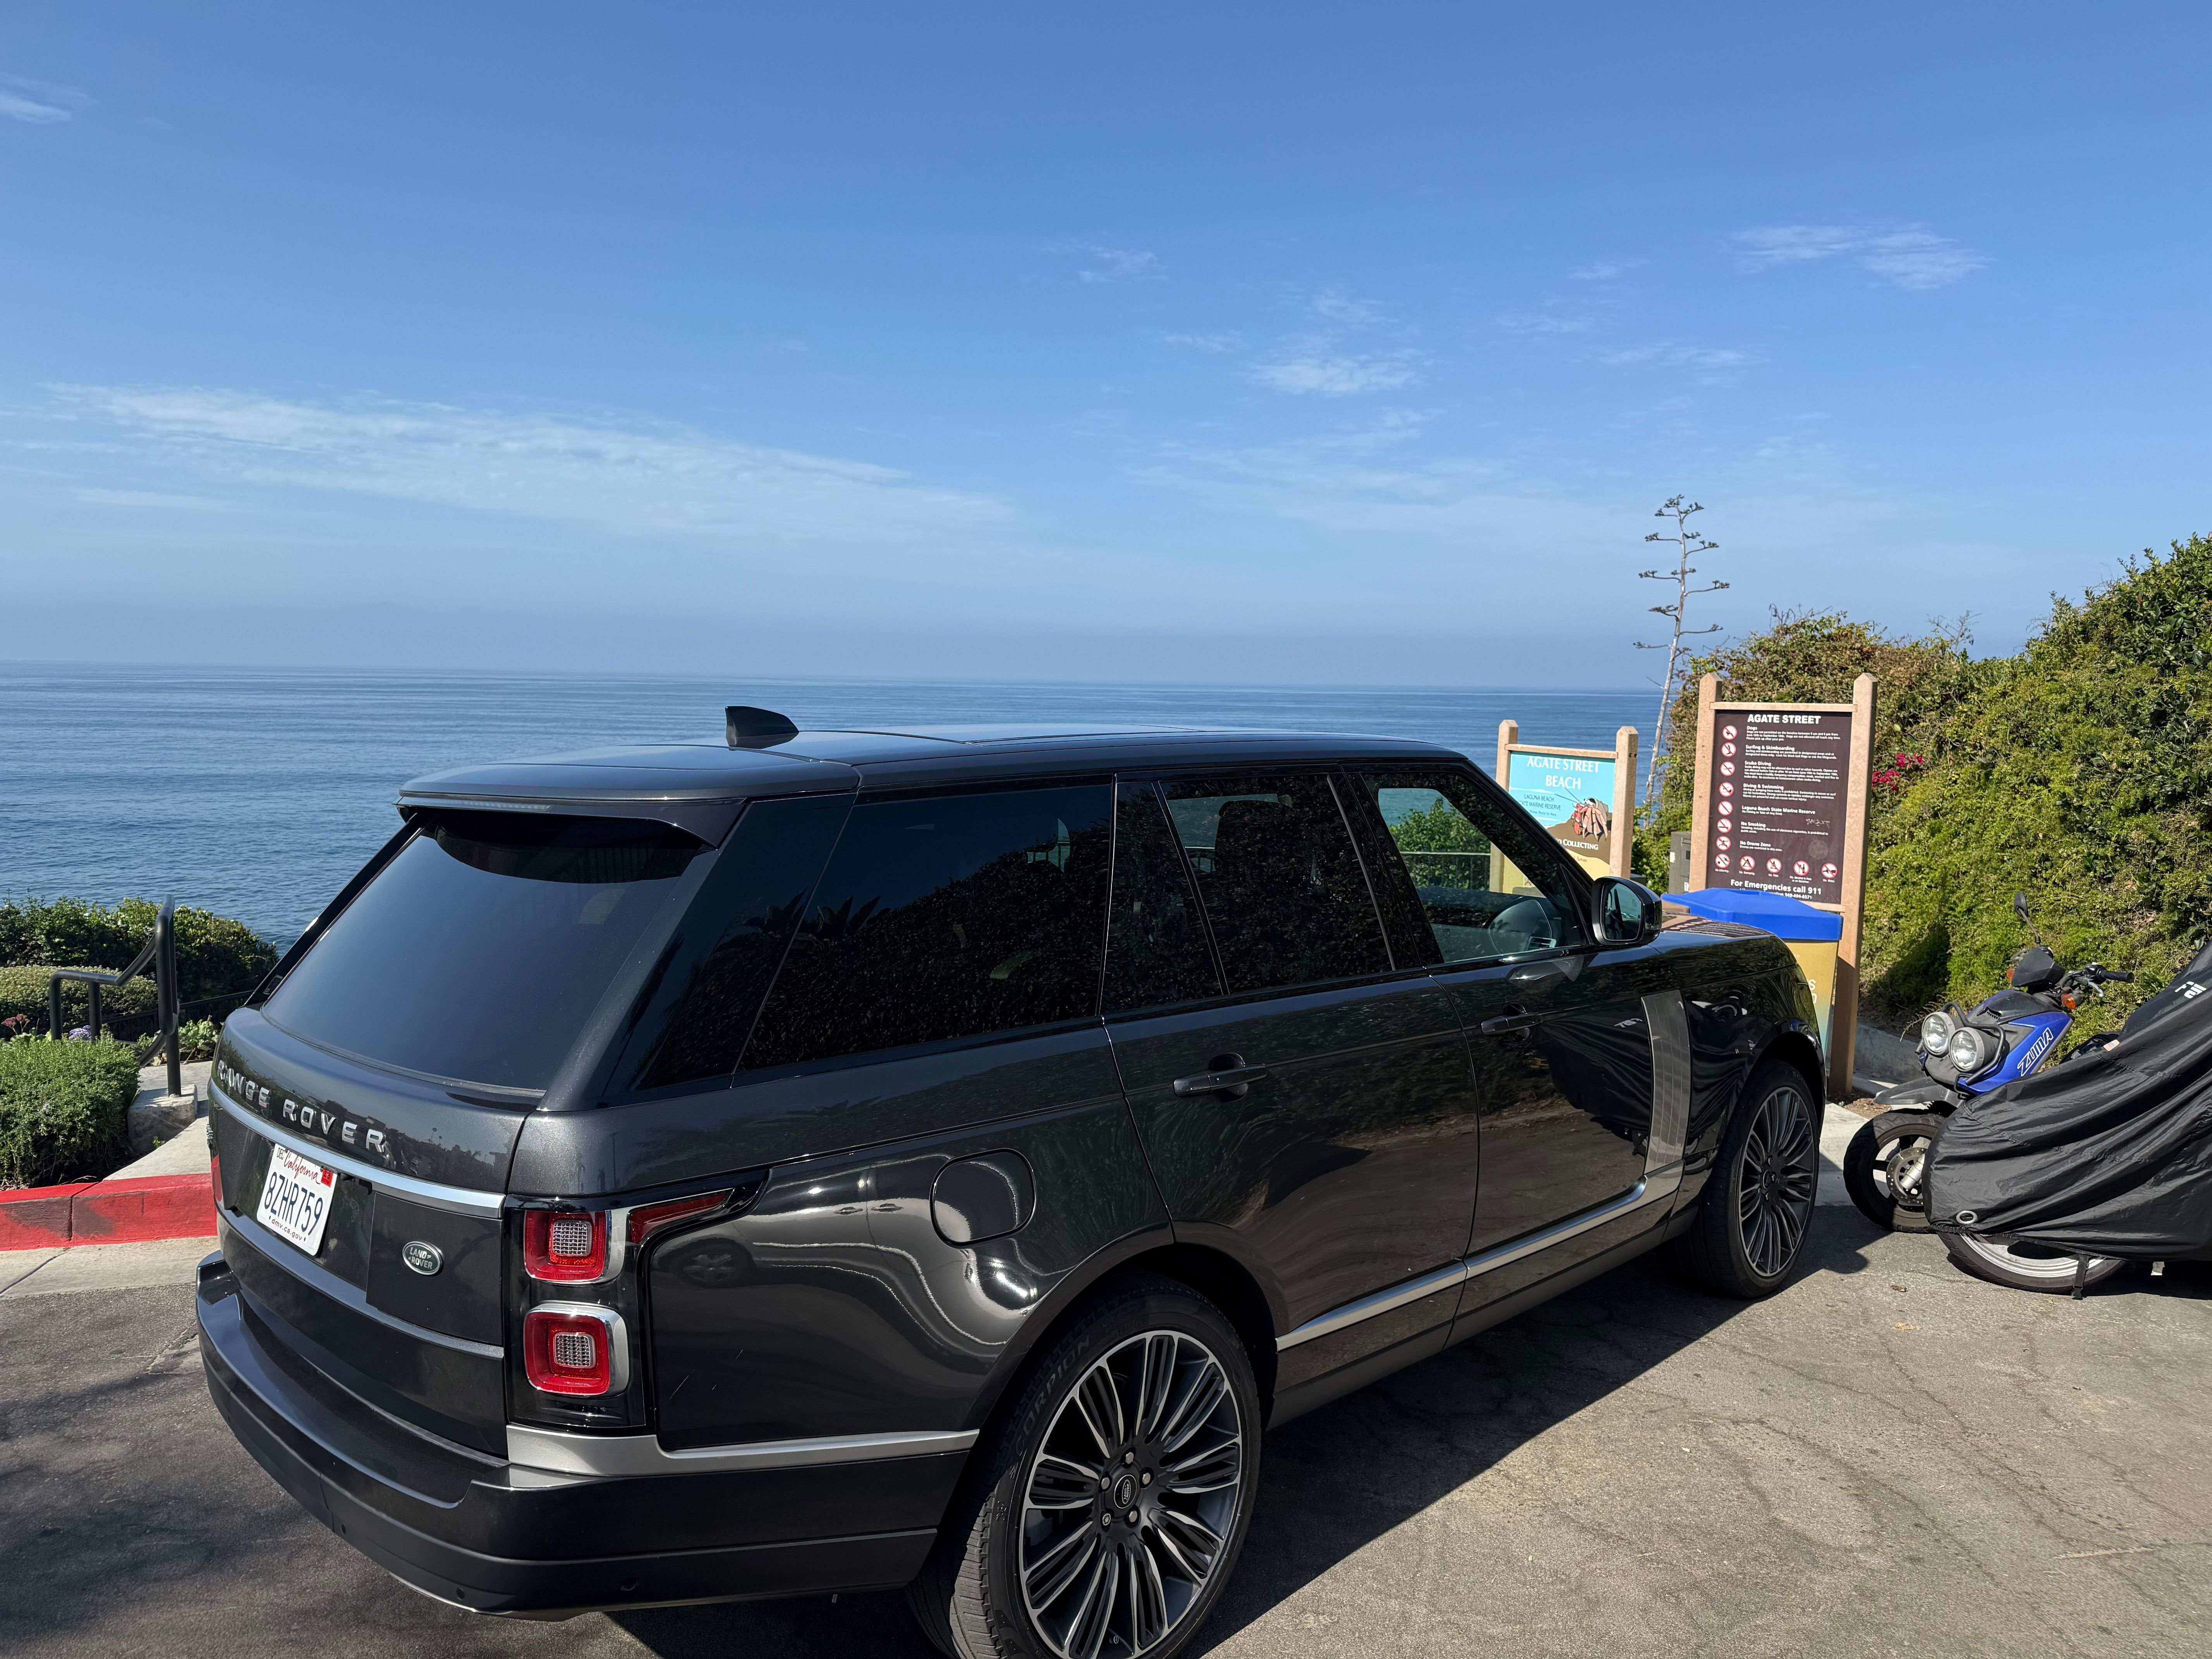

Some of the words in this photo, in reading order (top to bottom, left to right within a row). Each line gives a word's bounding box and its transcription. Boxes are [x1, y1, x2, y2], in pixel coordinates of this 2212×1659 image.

[1747, 714, 1780, 723] AGATE
[1782, 715, 1821, 724] STREET
[1526, 756, 1561, 769] AGATE
[1563, 759, 1599, 773] STREET
[1546, 775, 1581, 789] BEACH
[1563, 839, 1599, 850] COLLECTING
[1744, 881, 1791, 892] Emergencies
[1808, 887, 1821, 895] 911
[2017, 1027, 2054, 1077] ZUMA
[217, 1060, 270, 1108] RANGE
[283, 1099, 385, 1152] ROVER
[277, 1147, 285, 1160] DEC
[284, 1151, 321, 1185] California
[264, 1172, 323, 1236] 8ZHR759
[271, 1218, 302, 1241] dmv.ca.gov
[410, 1247, 427, 1259] LAND
[411, 1256, 433, 1269] ROVER
